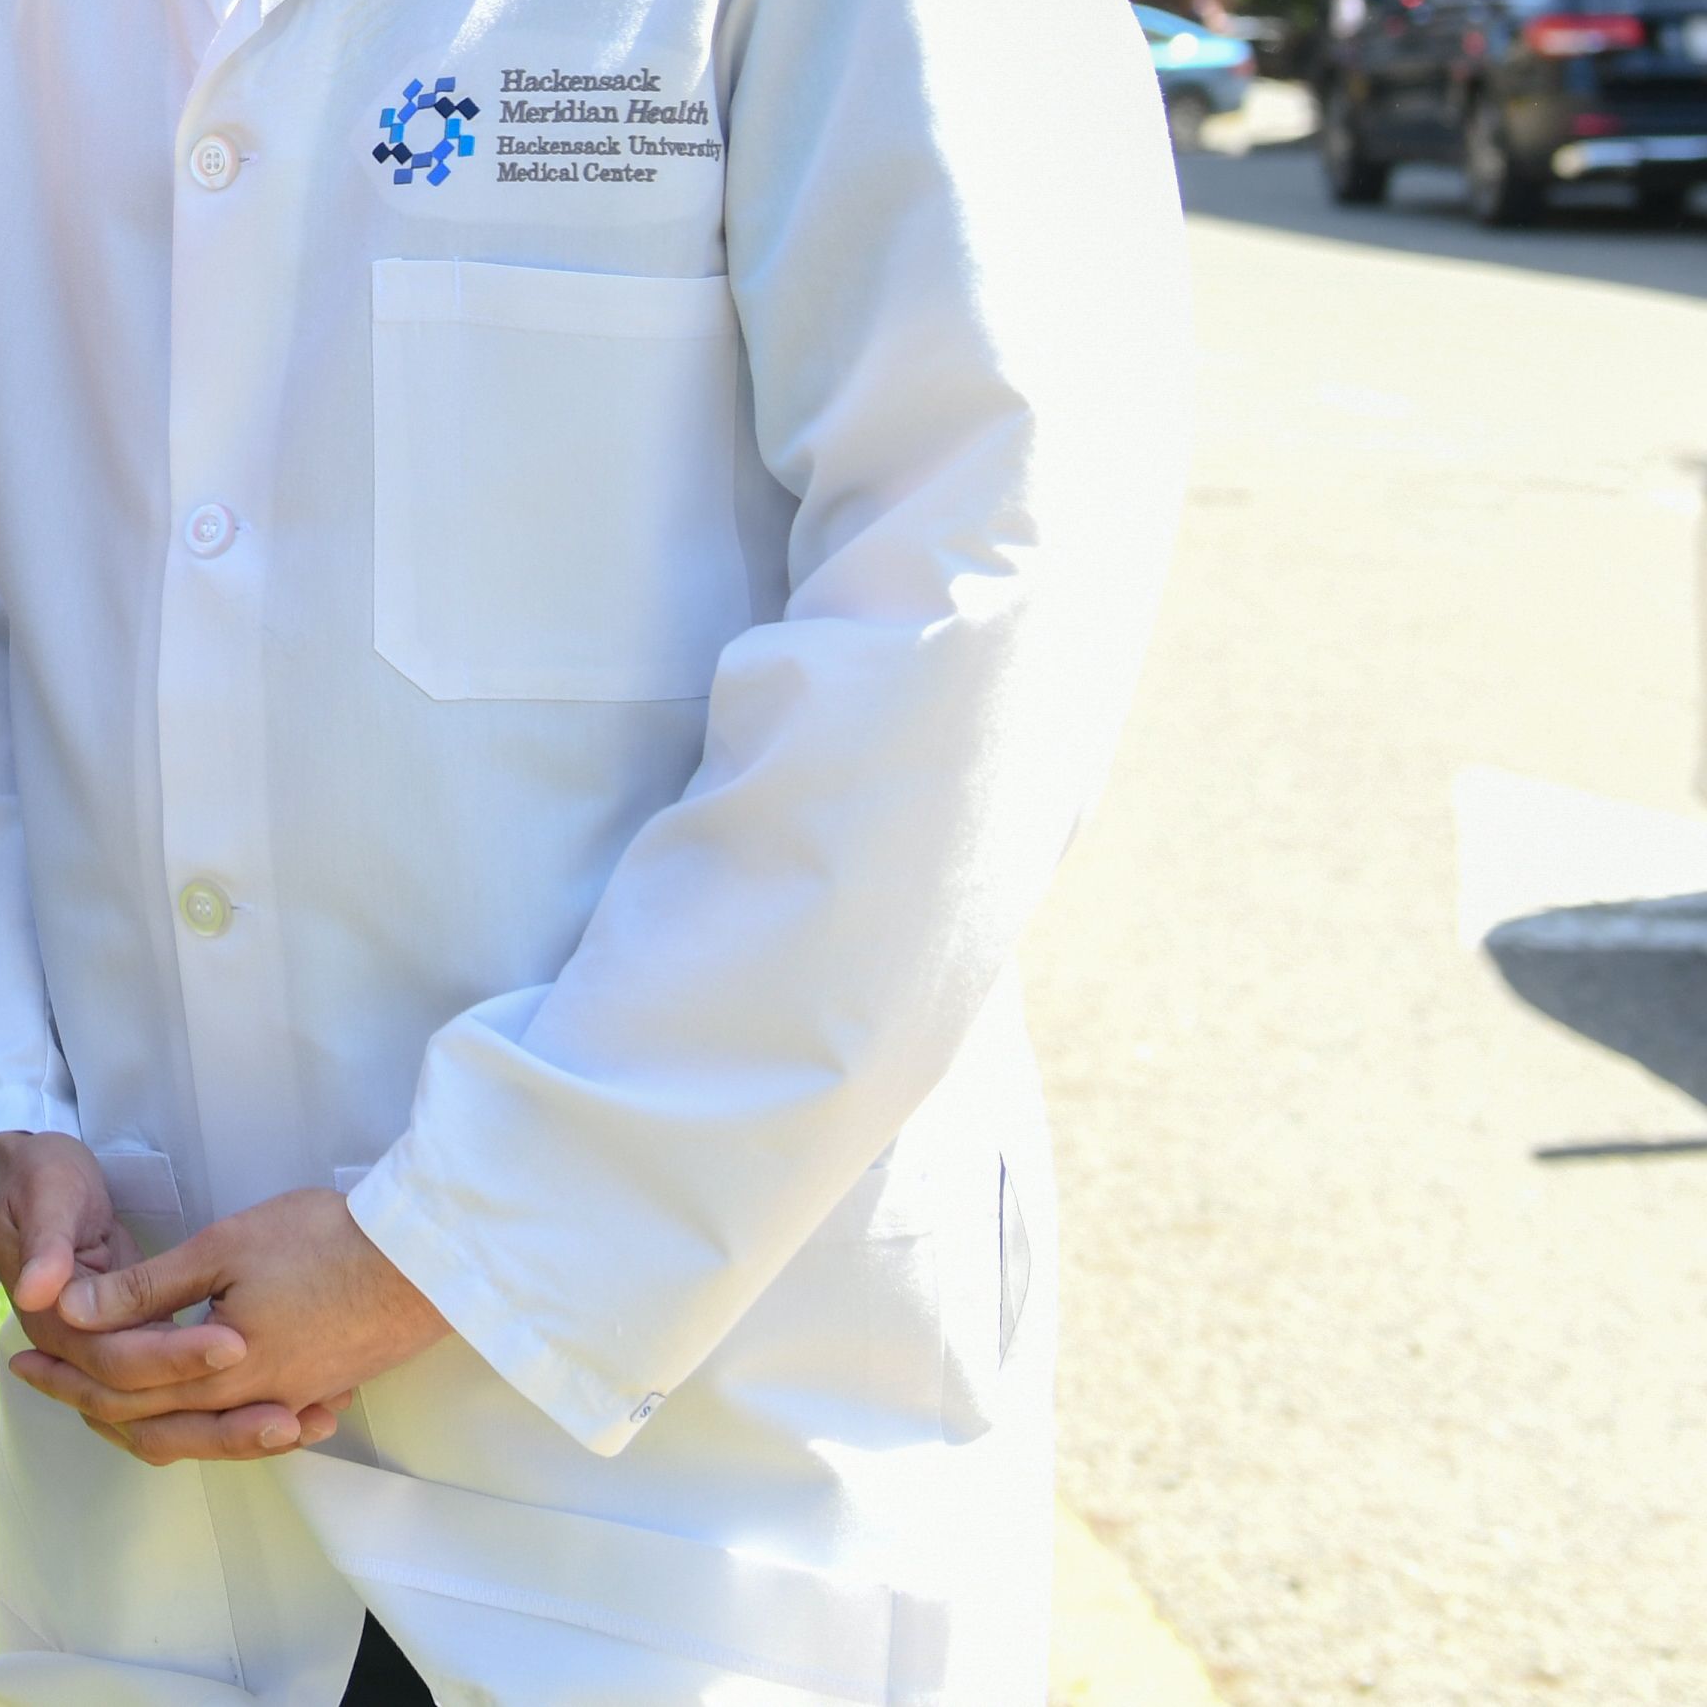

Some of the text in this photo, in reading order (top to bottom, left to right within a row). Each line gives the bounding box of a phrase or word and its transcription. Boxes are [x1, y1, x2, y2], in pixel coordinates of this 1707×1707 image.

[500, 68, 661, 92] Hackensack
[499, 99, 709, 125] Meridian Health
[496, 135, 722, 161] Hackensack University
[497, 162, 658, 182] Medical Center
